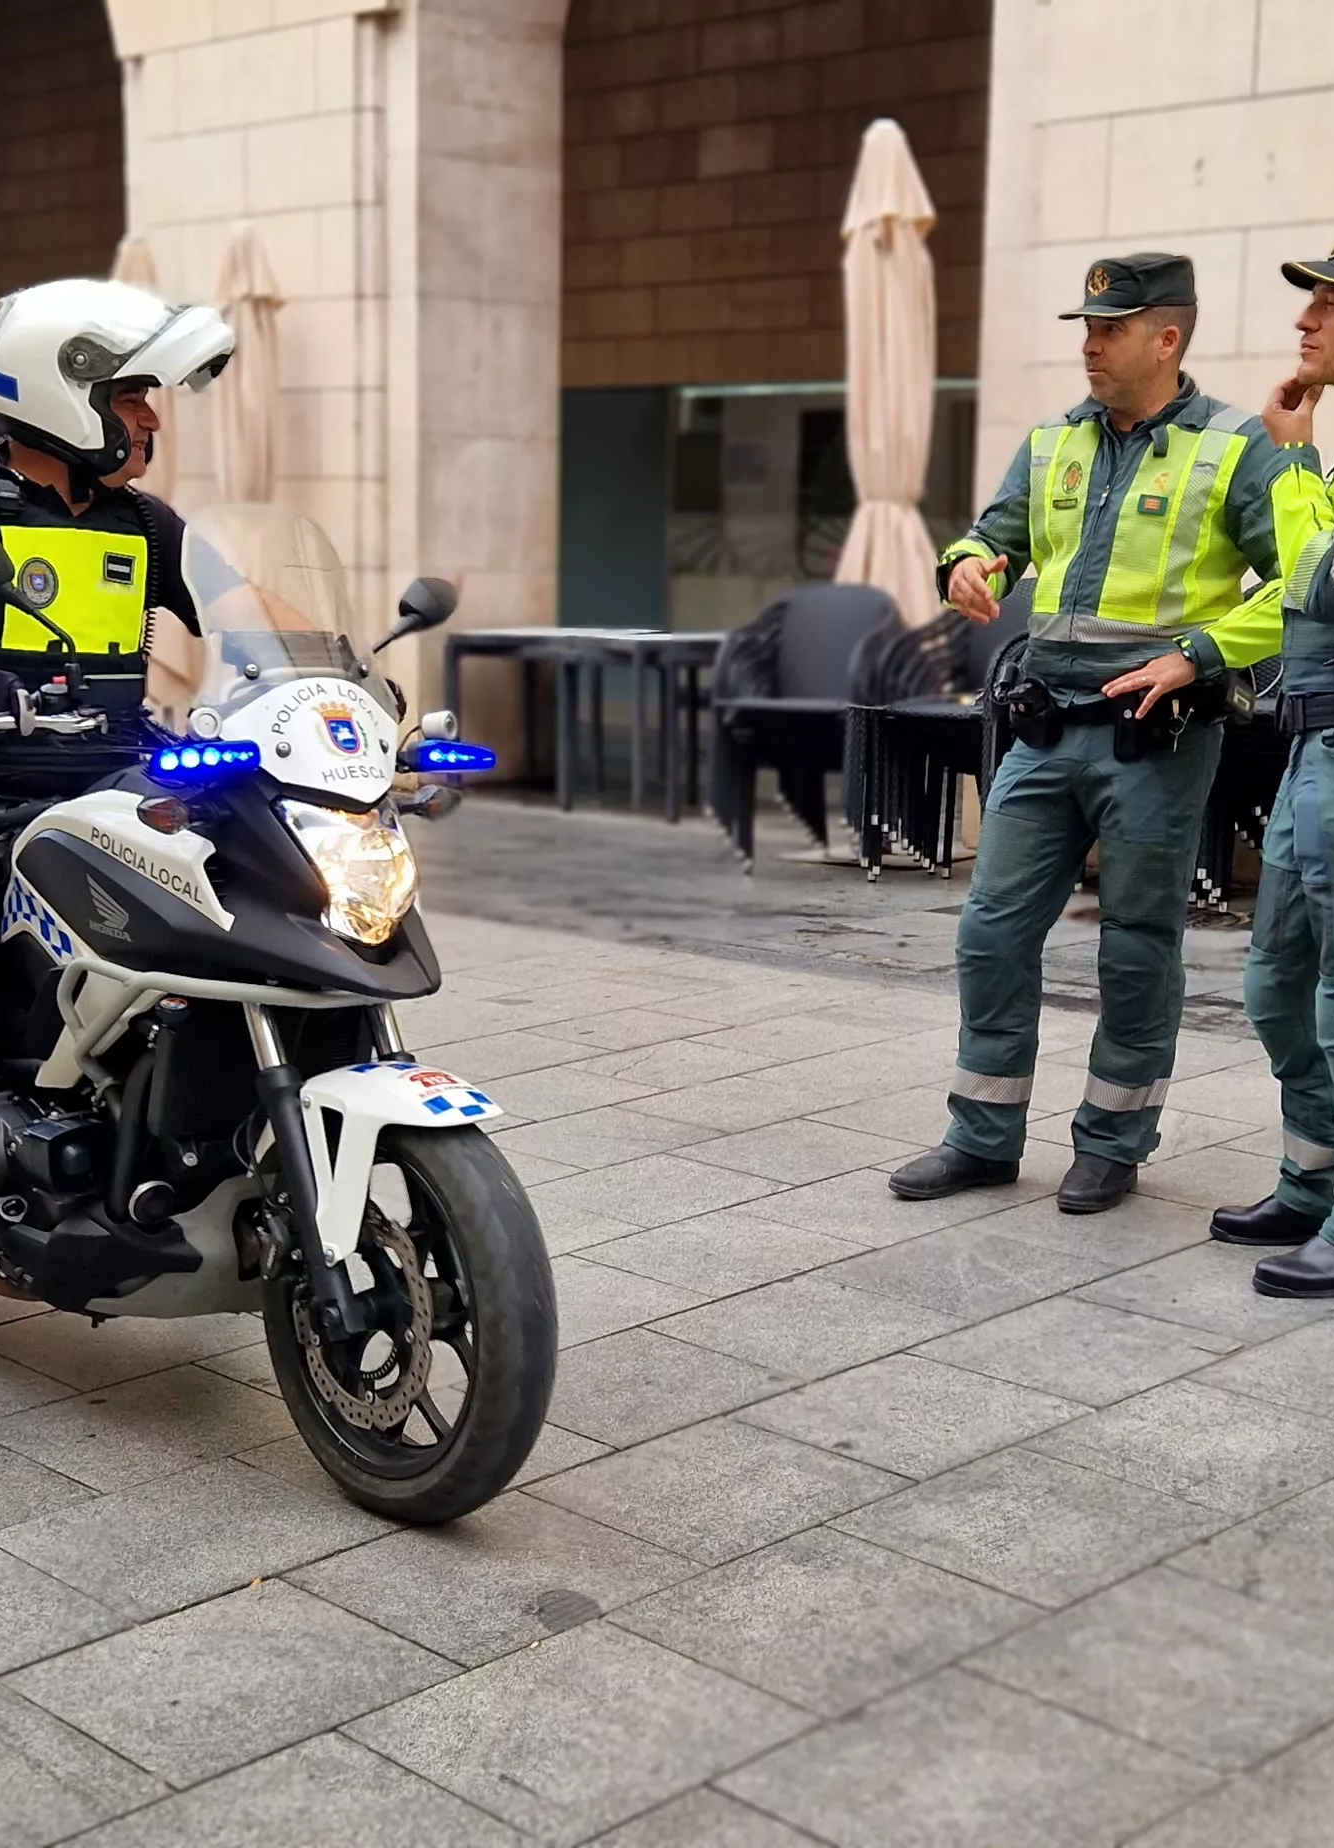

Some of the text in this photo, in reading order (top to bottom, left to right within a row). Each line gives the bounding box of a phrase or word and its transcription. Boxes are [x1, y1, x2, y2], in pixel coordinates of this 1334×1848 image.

[271, 683, 328, 735] POLICIA
[322, 765, 388, 783] HUESCA
[90, 826, 203, 904] POLICIA LOCAL
